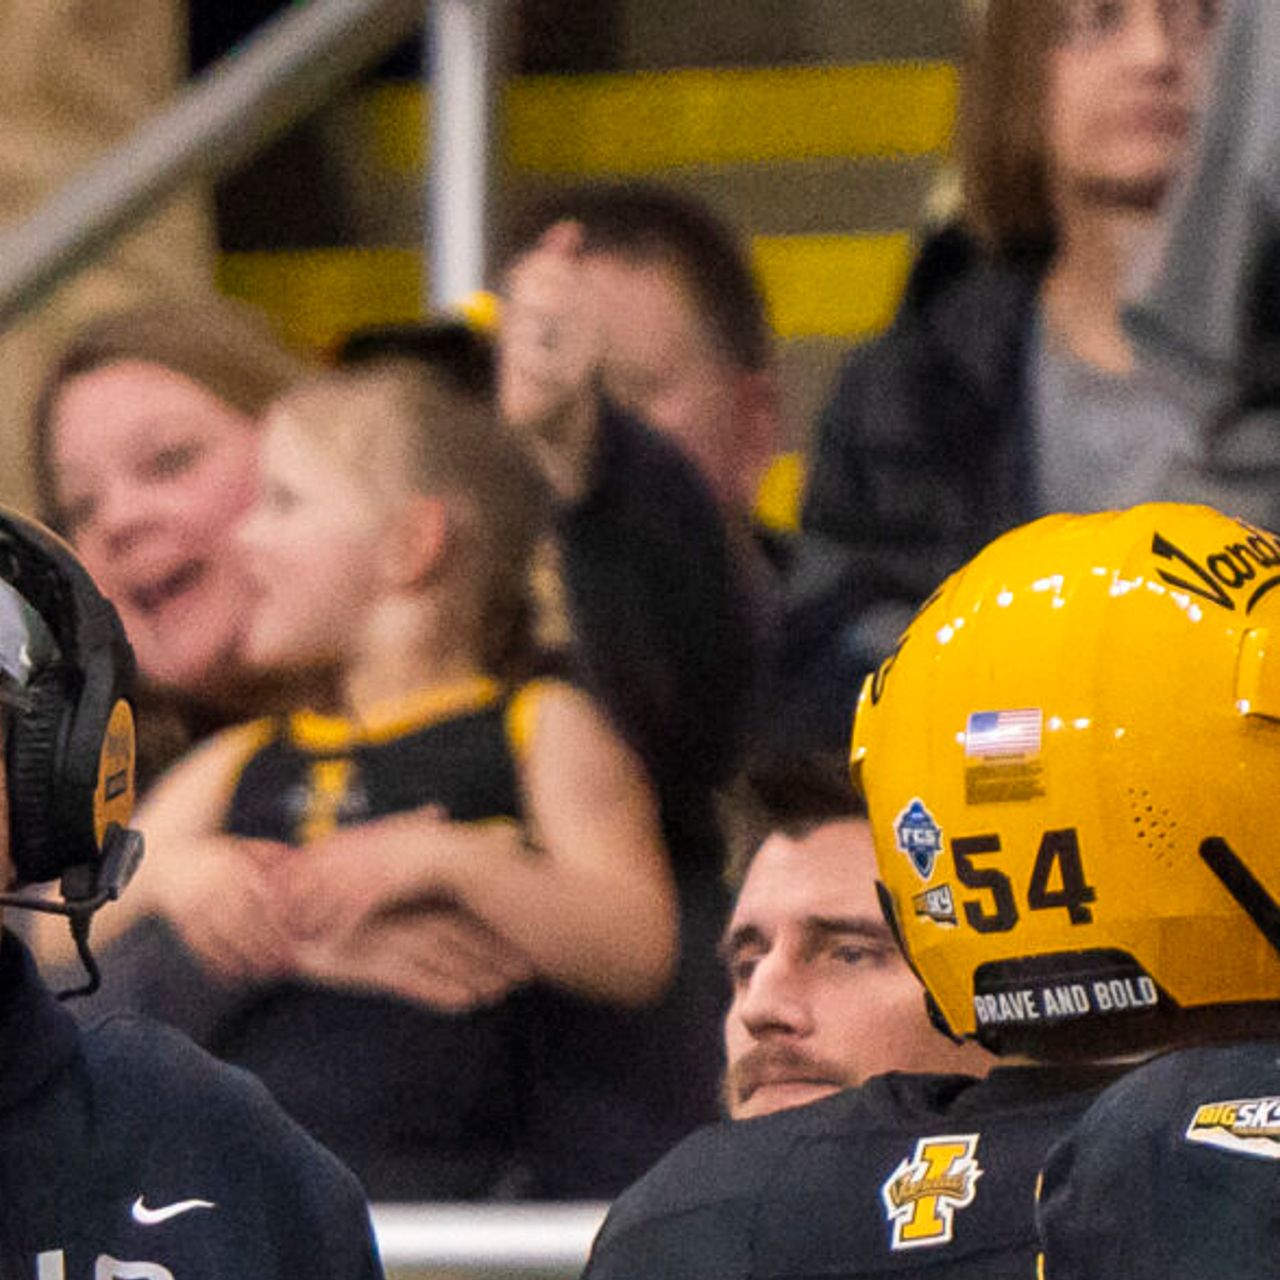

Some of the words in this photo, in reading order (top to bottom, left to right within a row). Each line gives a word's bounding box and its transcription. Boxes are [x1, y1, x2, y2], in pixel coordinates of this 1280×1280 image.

[901, 827, 937, 846] FCS
[951, 828, 1097, 934] 54
[975, 991, 1039, 1024] BRAVE
[1043, 985, 1090, 1016] AND
[1093, 976, 1158, 1010] BOLD
